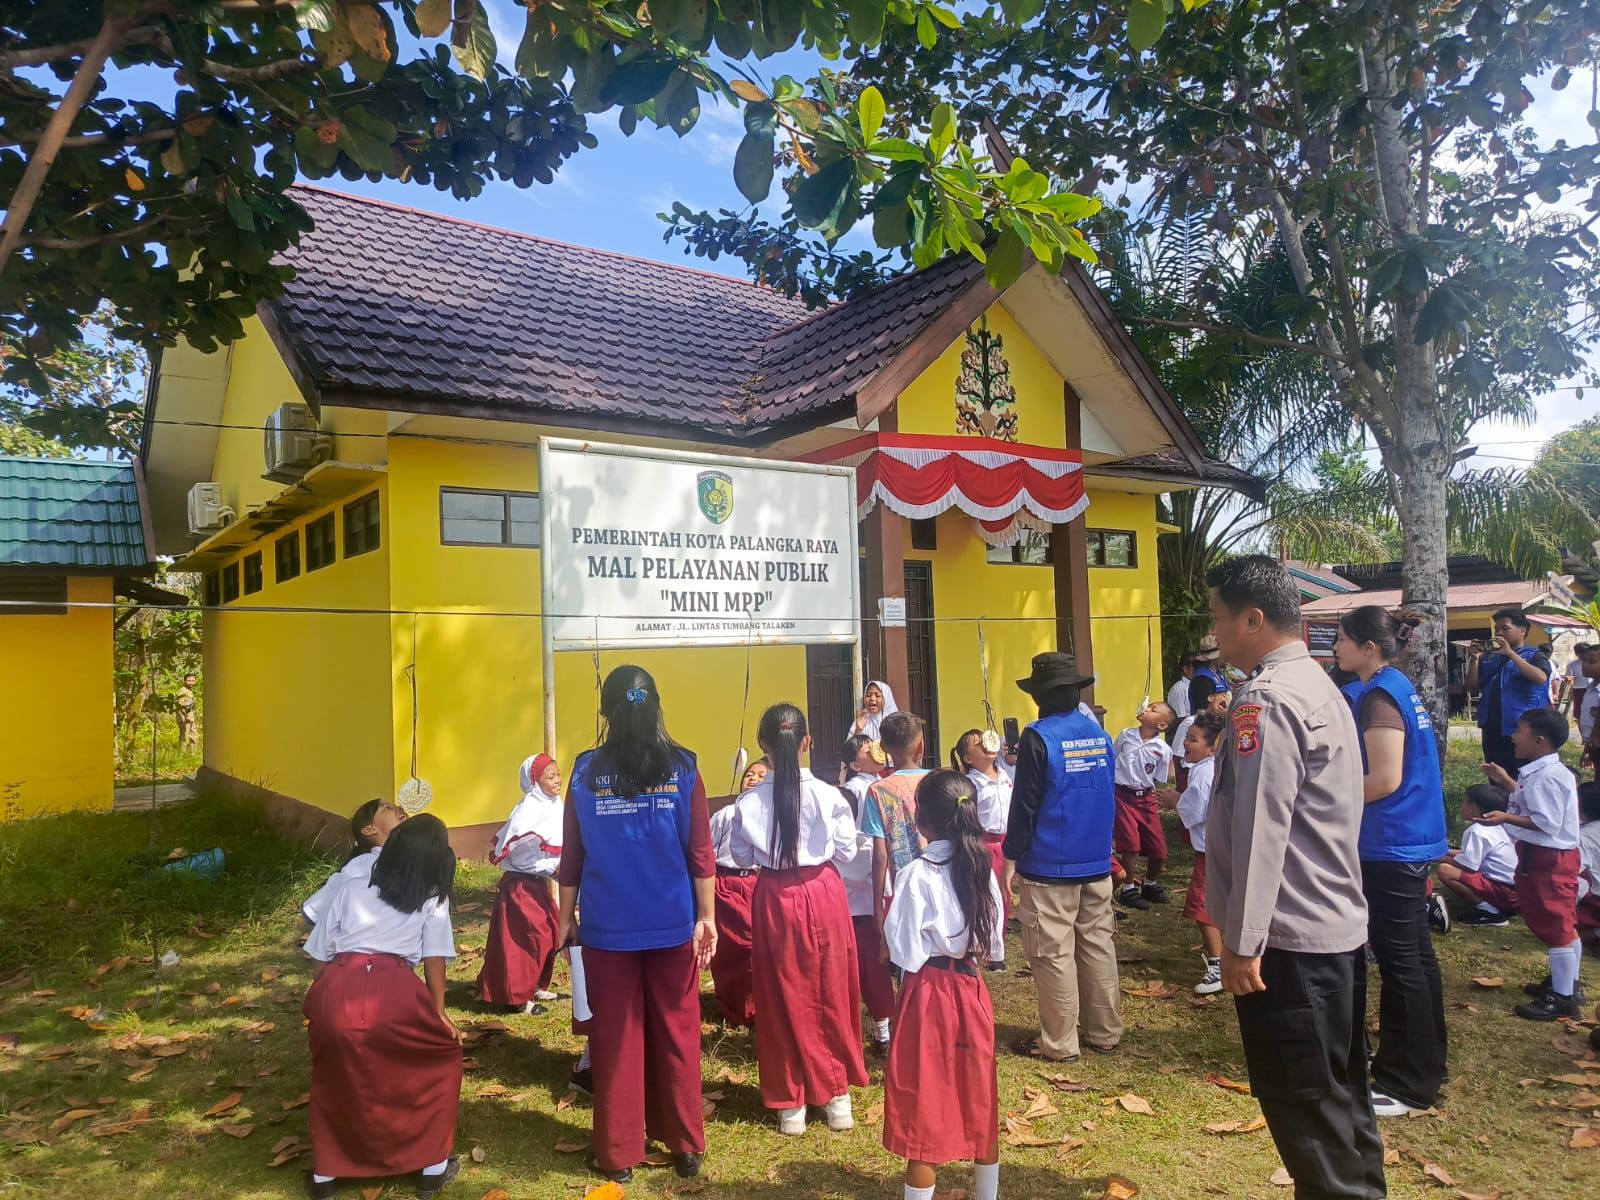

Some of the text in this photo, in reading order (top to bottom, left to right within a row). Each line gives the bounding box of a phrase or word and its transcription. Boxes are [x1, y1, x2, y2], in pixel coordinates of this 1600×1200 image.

[572, 527, 839, 554] PEMERINTAH KOTA PALANGKA RAYA
[587, 555, 829, 582] MAL PELAYANAN PUBLIK
[635, 623, 671, 632] ALAMAT
[692, 622, 720, 631] LINTAS
[722, 621, 760, 630] TUMBANG
[762, 621, 796, 630] TALAKEN
